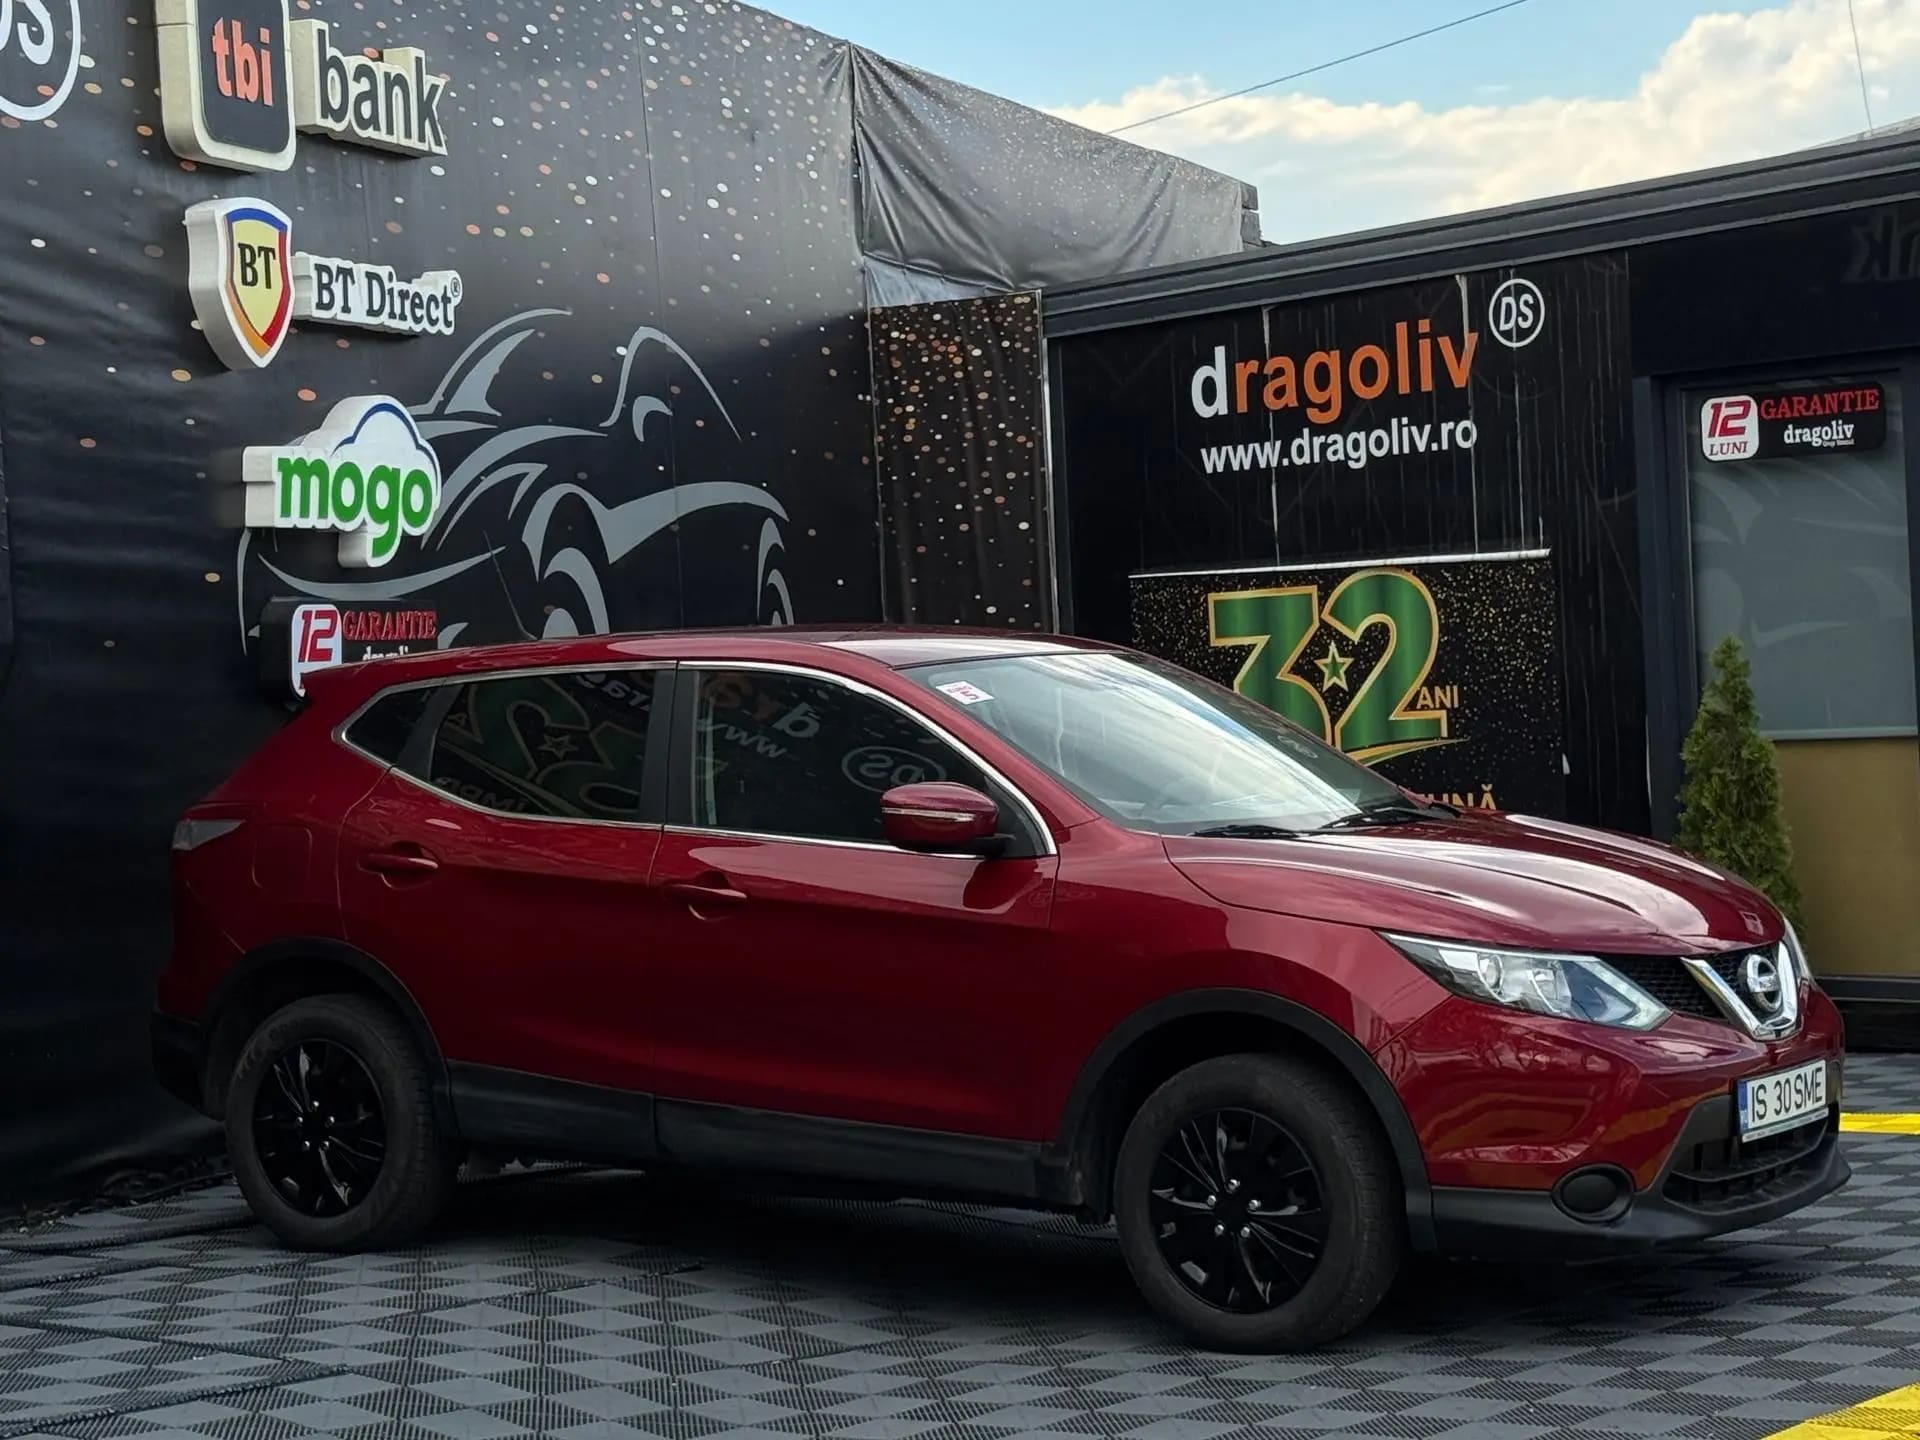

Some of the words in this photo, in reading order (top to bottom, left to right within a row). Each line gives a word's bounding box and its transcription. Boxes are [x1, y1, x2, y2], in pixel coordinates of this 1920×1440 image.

[213, 17, 273, 106] tbi
[318, 29, 441, 147] bank
[238, 243, 276, 289] BT
[314, 263, 355, 313] BT
[1499, 294, 1534, 331] DS
[1191, 319, 1479, 424] dragoliv
[1709, 401, 1750, 438] 12
[1761, 390, 1879, 420] GARANTIE
[1201, 418, 1477, 470] www.dragoliv.ro
[1709, 442, 1748, 456] LUNI
[1784, 420, 1854, 446] dragoliv
[277, 457, 432, 558] mogo
[298, 610, 338, 662] 12
[342, 610, 436, 640] GARANTIE
[1208, 568, 1447, 750] 32
[1417, 686, 1459, 710] ANI
[1752, 1084, 1767, 1122] IS
[1774, 1078, 1792, 1117] 30
[1794, 1067, 1823, 1109] SME
